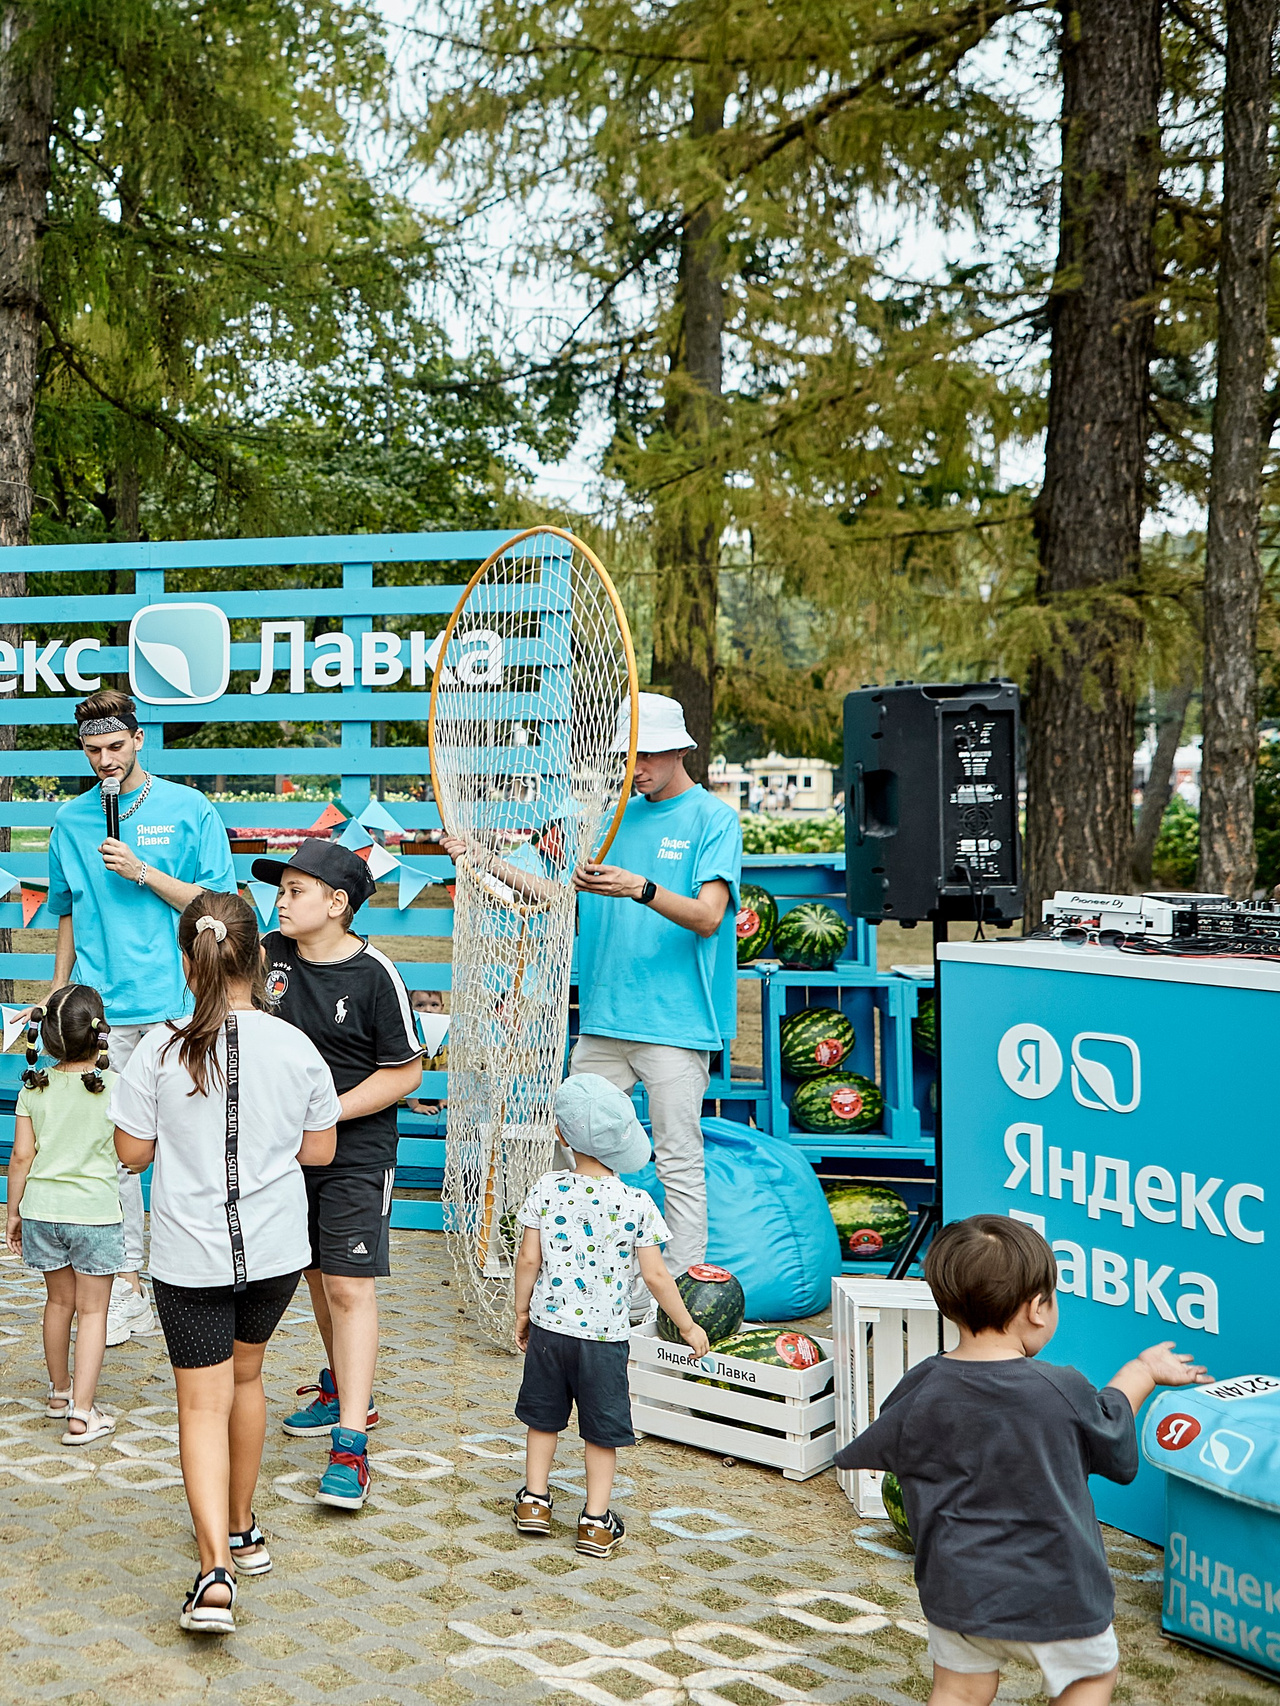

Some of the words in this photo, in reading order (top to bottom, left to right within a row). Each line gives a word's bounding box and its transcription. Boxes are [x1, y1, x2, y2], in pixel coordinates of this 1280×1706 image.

[250, 620, 504, 696] Лавка
[136, 824, 175, 834] Яндекс
[137, 835, 170, 846] Лавка
[1070, 896, 1110, 906] Pioneer
[1017, 1038, 1041, 1085] Я
[1003, 1121, 1265, 1244] Яндекс
[657, 1347, 700, 1368] Яндекс
[716, 1362, 757, 1383] Лавка
[1162, 1419, 1192, 1446] Я
